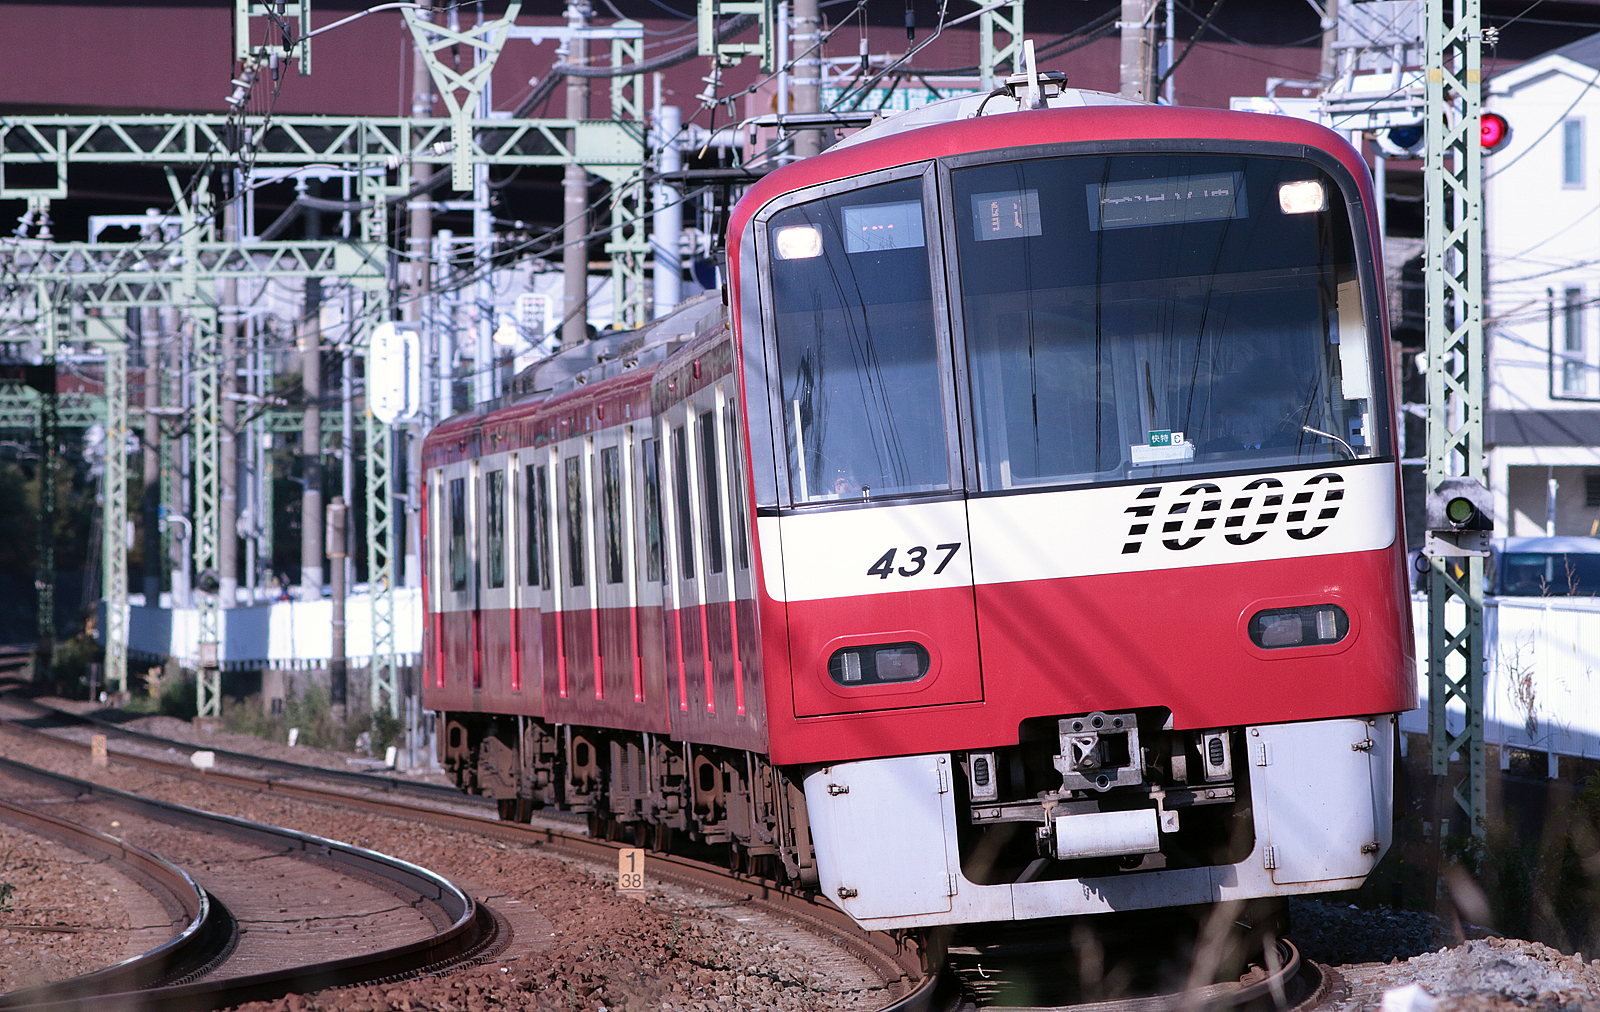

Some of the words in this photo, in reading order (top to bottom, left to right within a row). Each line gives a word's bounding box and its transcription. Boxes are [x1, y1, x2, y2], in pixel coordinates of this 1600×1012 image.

[1151, 433, 1169, 443] 快特
[1121, 473, 1345, 554] 1000
[866, 542, 962, 580] 437
[626, 851, 635, 872] 1
[621, 873, 642, 888] 38
